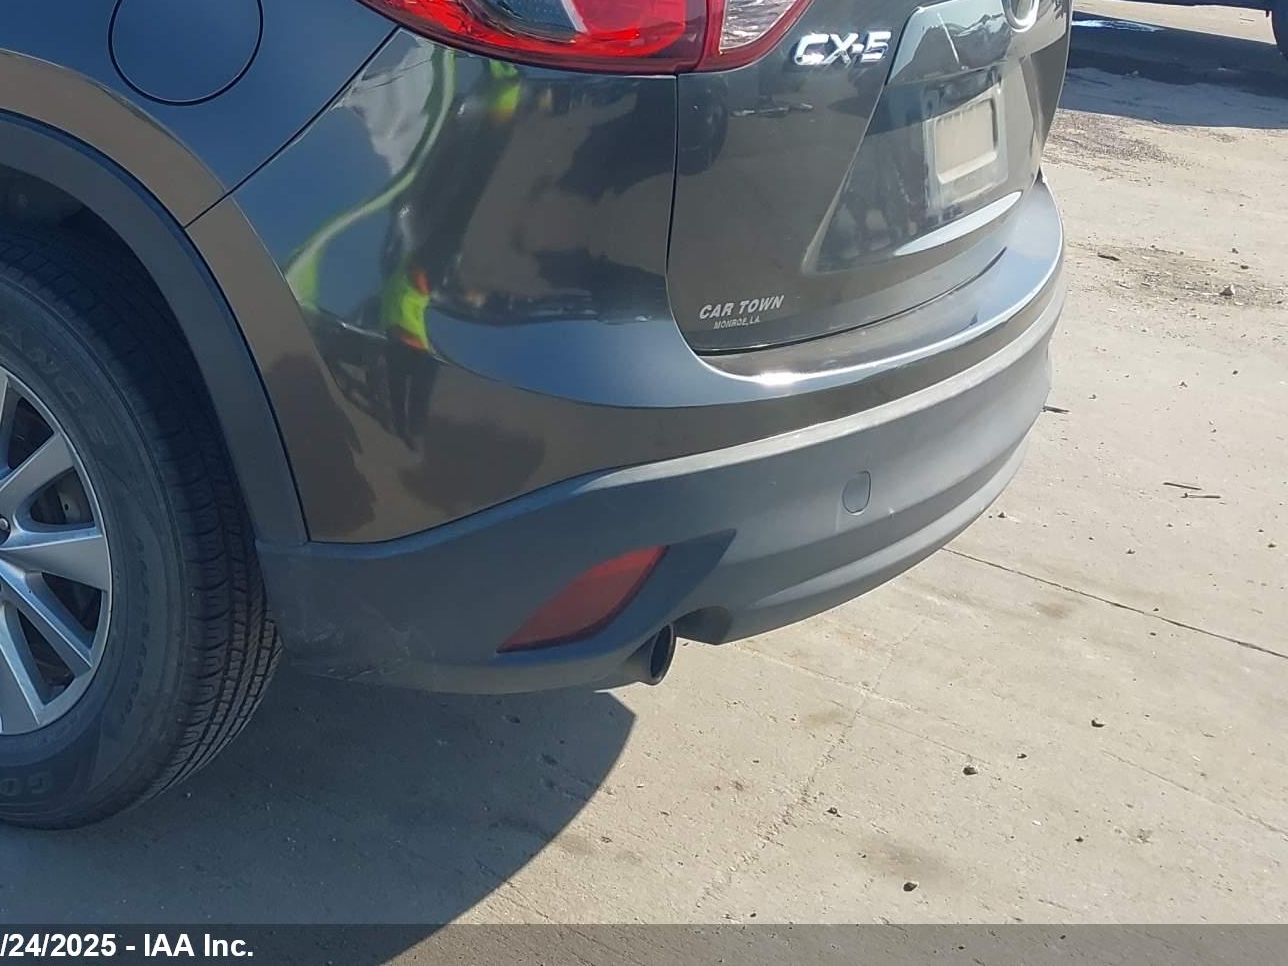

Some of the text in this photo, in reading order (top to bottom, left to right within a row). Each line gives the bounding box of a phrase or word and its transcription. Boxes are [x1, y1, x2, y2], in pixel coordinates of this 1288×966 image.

[794, 31, 892, 67] CX-5
[699, 295, 784, 320] CAR TOWN
